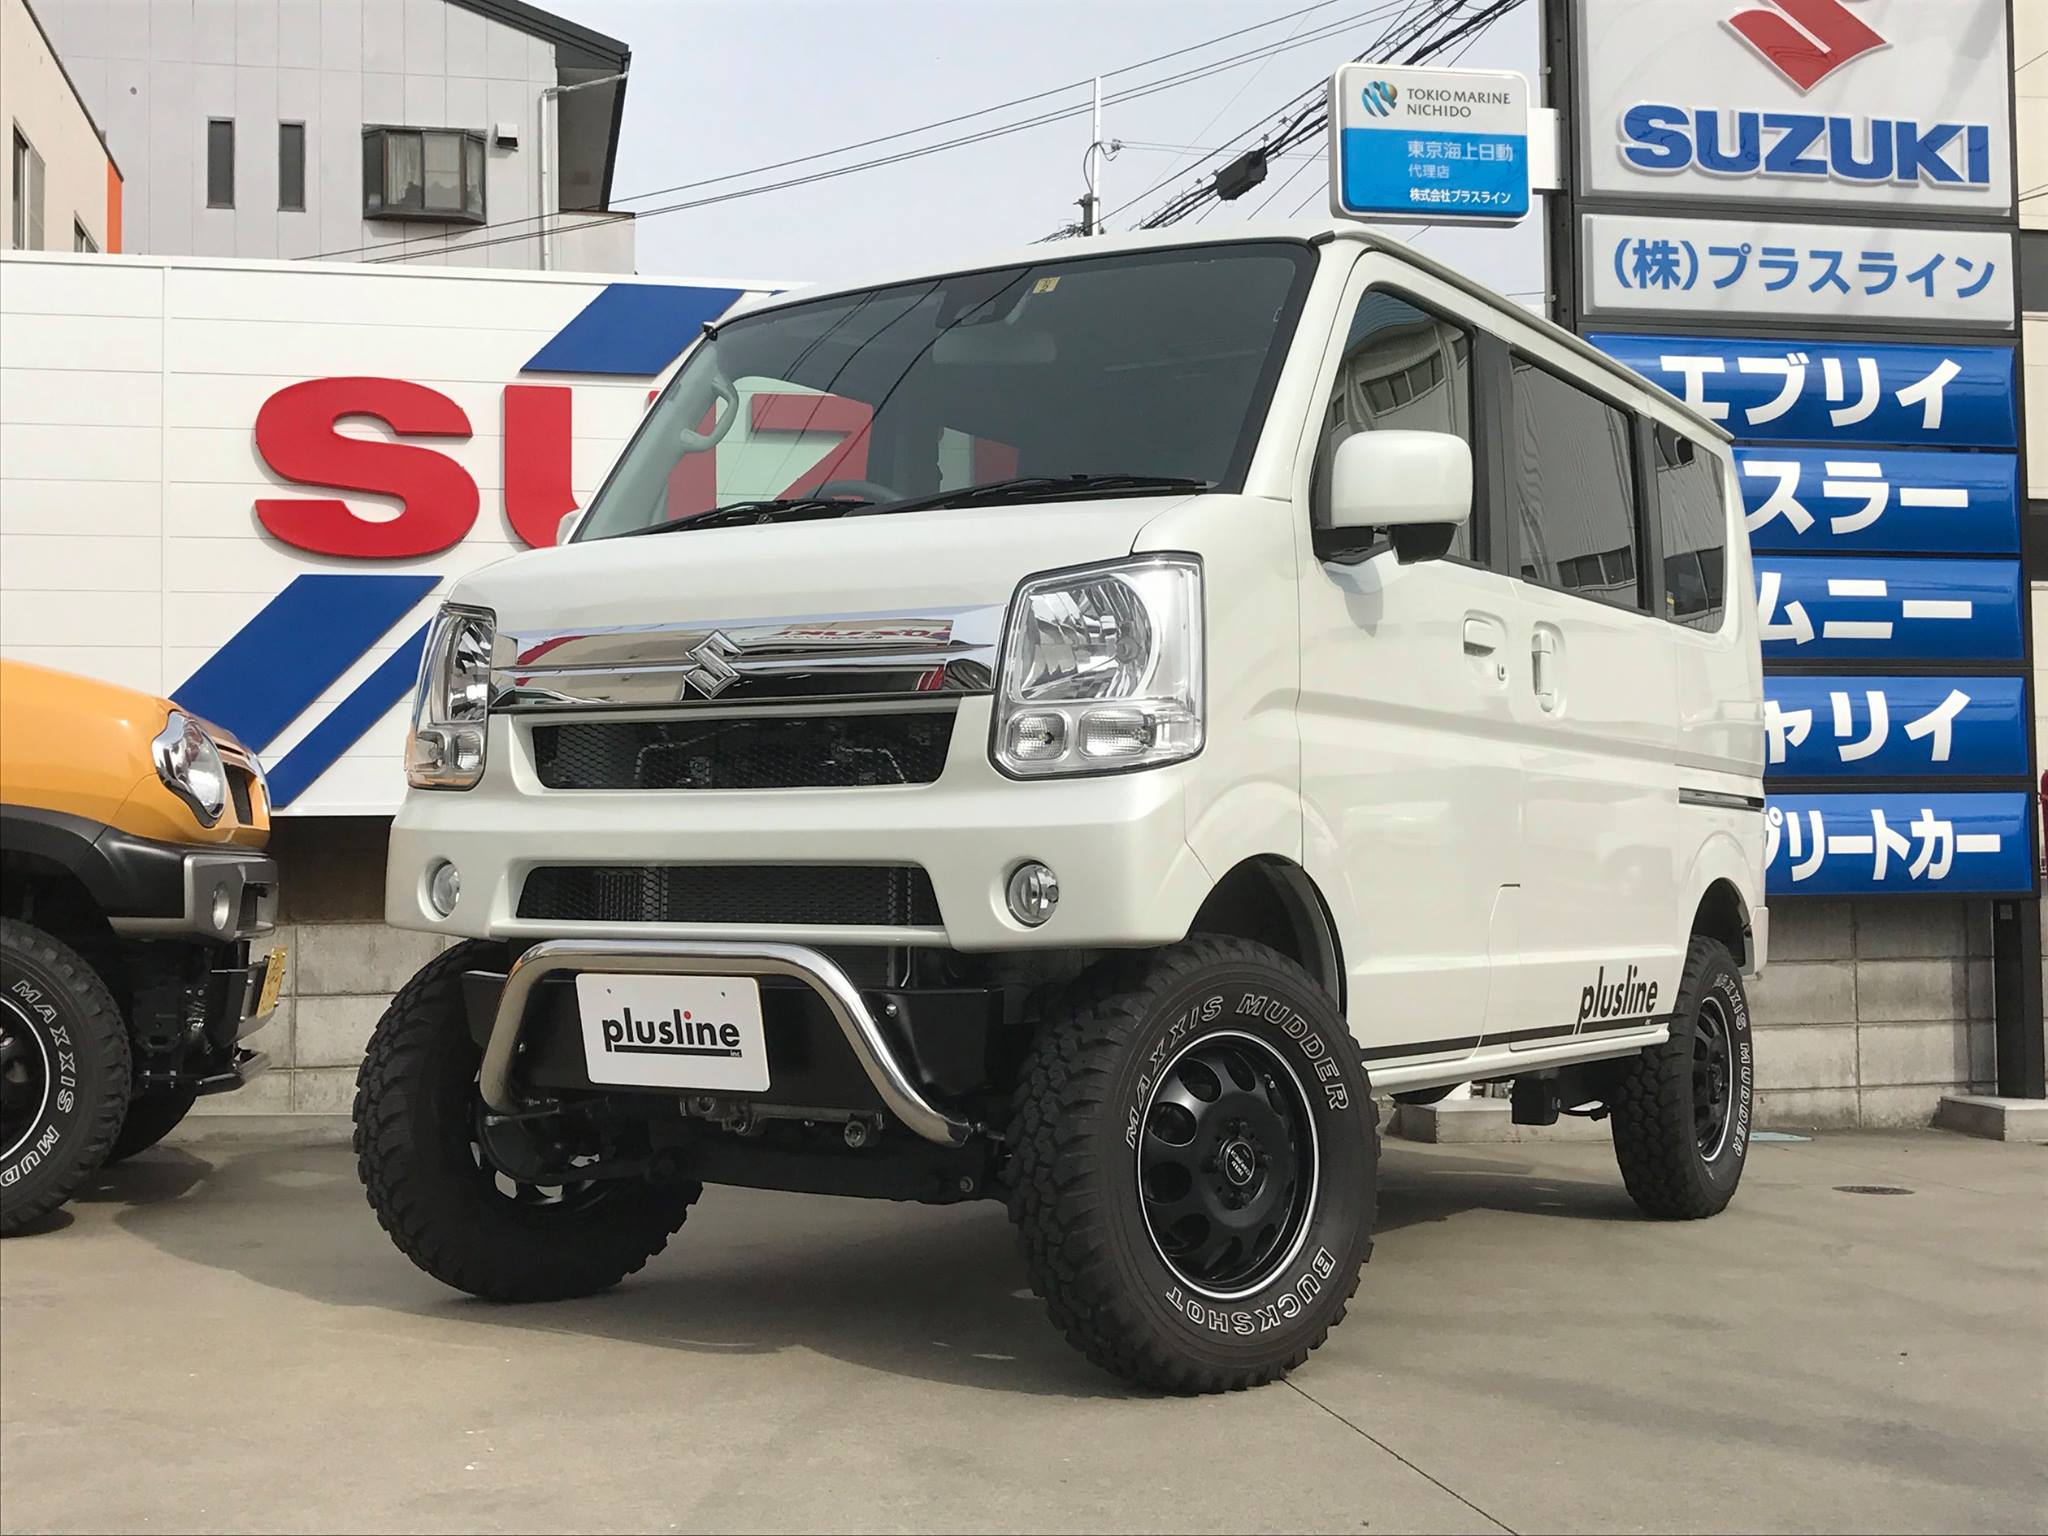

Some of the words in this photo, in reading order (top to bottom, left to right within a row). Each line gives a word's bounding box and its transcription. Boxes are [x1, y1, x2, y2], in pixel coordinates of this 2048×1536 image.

[1407, 88, 1450, 102] TOKIO
[1453, 90, 1511, 105] MARINE
[1407, 104, 1471, 118] NICHIDO
[1407, 140, 1514, 162] 東京海上日動
[1408, 164, 1449, 179] 代理店
[1622, 103, 1991, 186] SUZUKI
[1410, 187, 1511, 205] 株式会社プラスライン
[1614, 237, 1995, 299] (株)プラスライン
[1742, 460, 1969, 535] スラー
[1757, 572, 1972, 645] ムニー
[602, 1007, 741, 1052] plusline
[1576, 964, 1658, 1035] plusline
[12, 980, 76, 1113] MAXXIS
[1126, 996, 1224, 1150] MAXXIS
[1236, 993, 1350, 1111] MUDDER
[1166, 1246, 1336, 1336] BUCKSHOT
